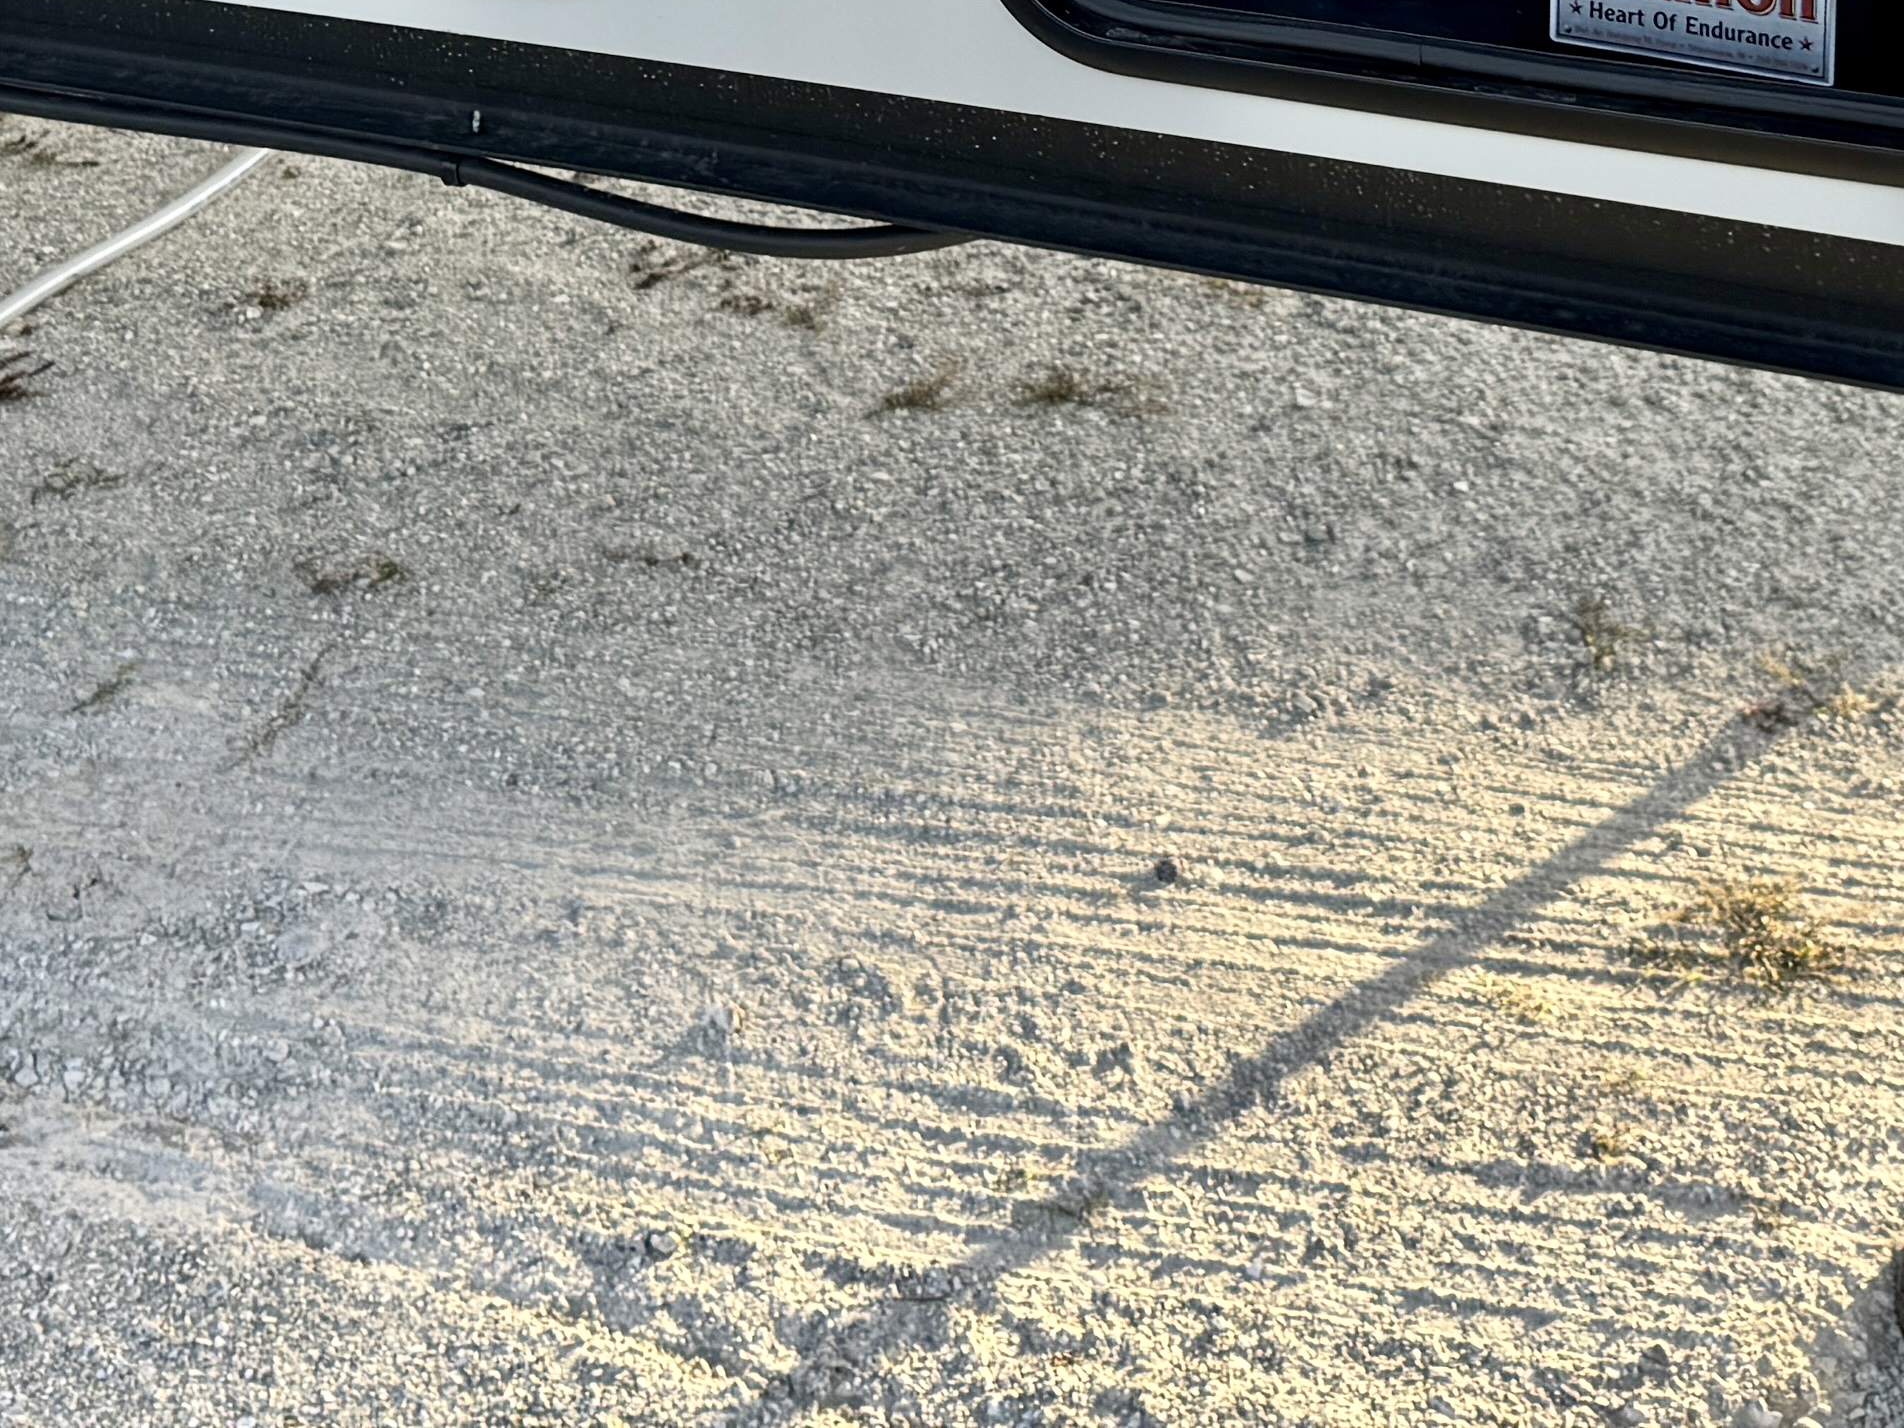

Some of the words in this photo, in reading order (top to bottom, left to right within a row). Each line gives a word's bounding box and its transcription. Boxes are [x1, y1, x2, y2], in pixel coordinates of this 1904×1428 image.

[1589, 0, 1645, 27] Heart
[1653, 11, 1676, 32] Of
[1685, 17, 1794, 51] Endurance
